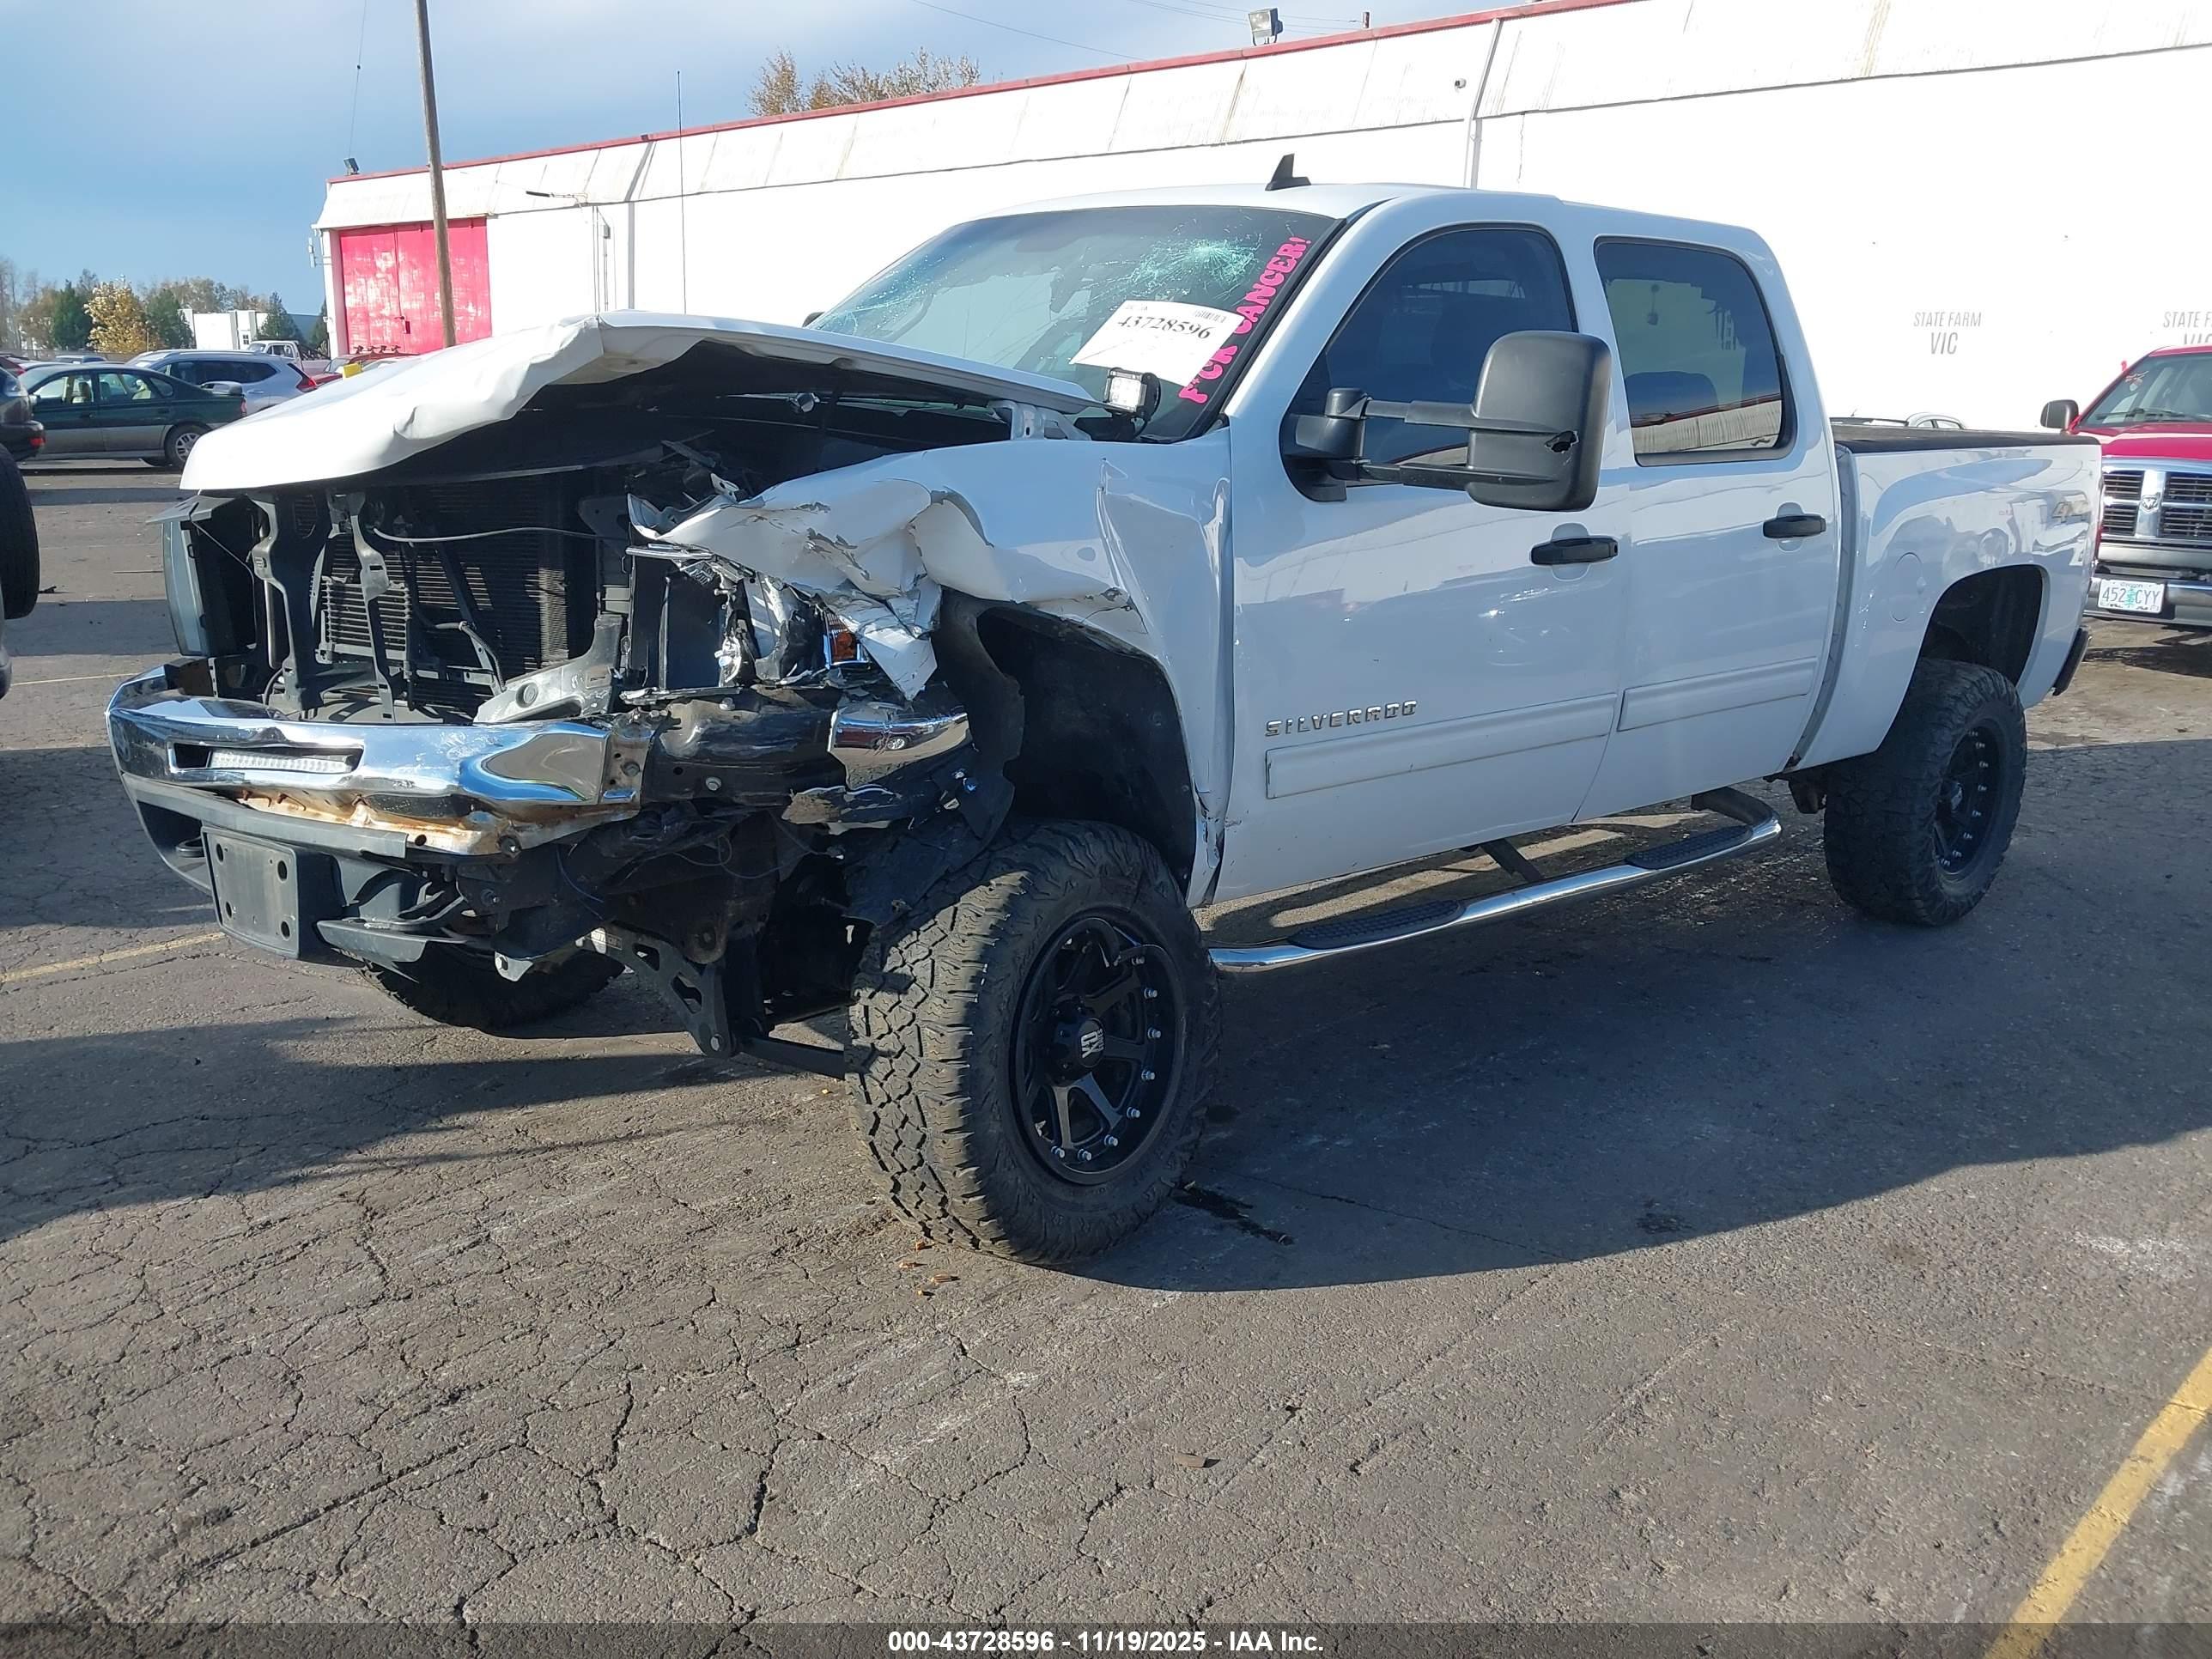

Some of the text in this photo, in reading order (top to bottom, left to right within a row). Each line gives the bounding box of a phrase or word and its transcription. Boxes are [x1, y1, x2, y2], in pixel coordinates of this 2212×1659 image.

[1118, 315, 1215, 340] 43728596
[1913, 311, 1982, 327] STATE FARM
[2163, 311, 2201, 328] STATE
[1930, 331, 1959, 355] VIC
[2102, 586, 2160, 605] 452 CYY
[1265, 700, 1417, 738] SILVERADO
